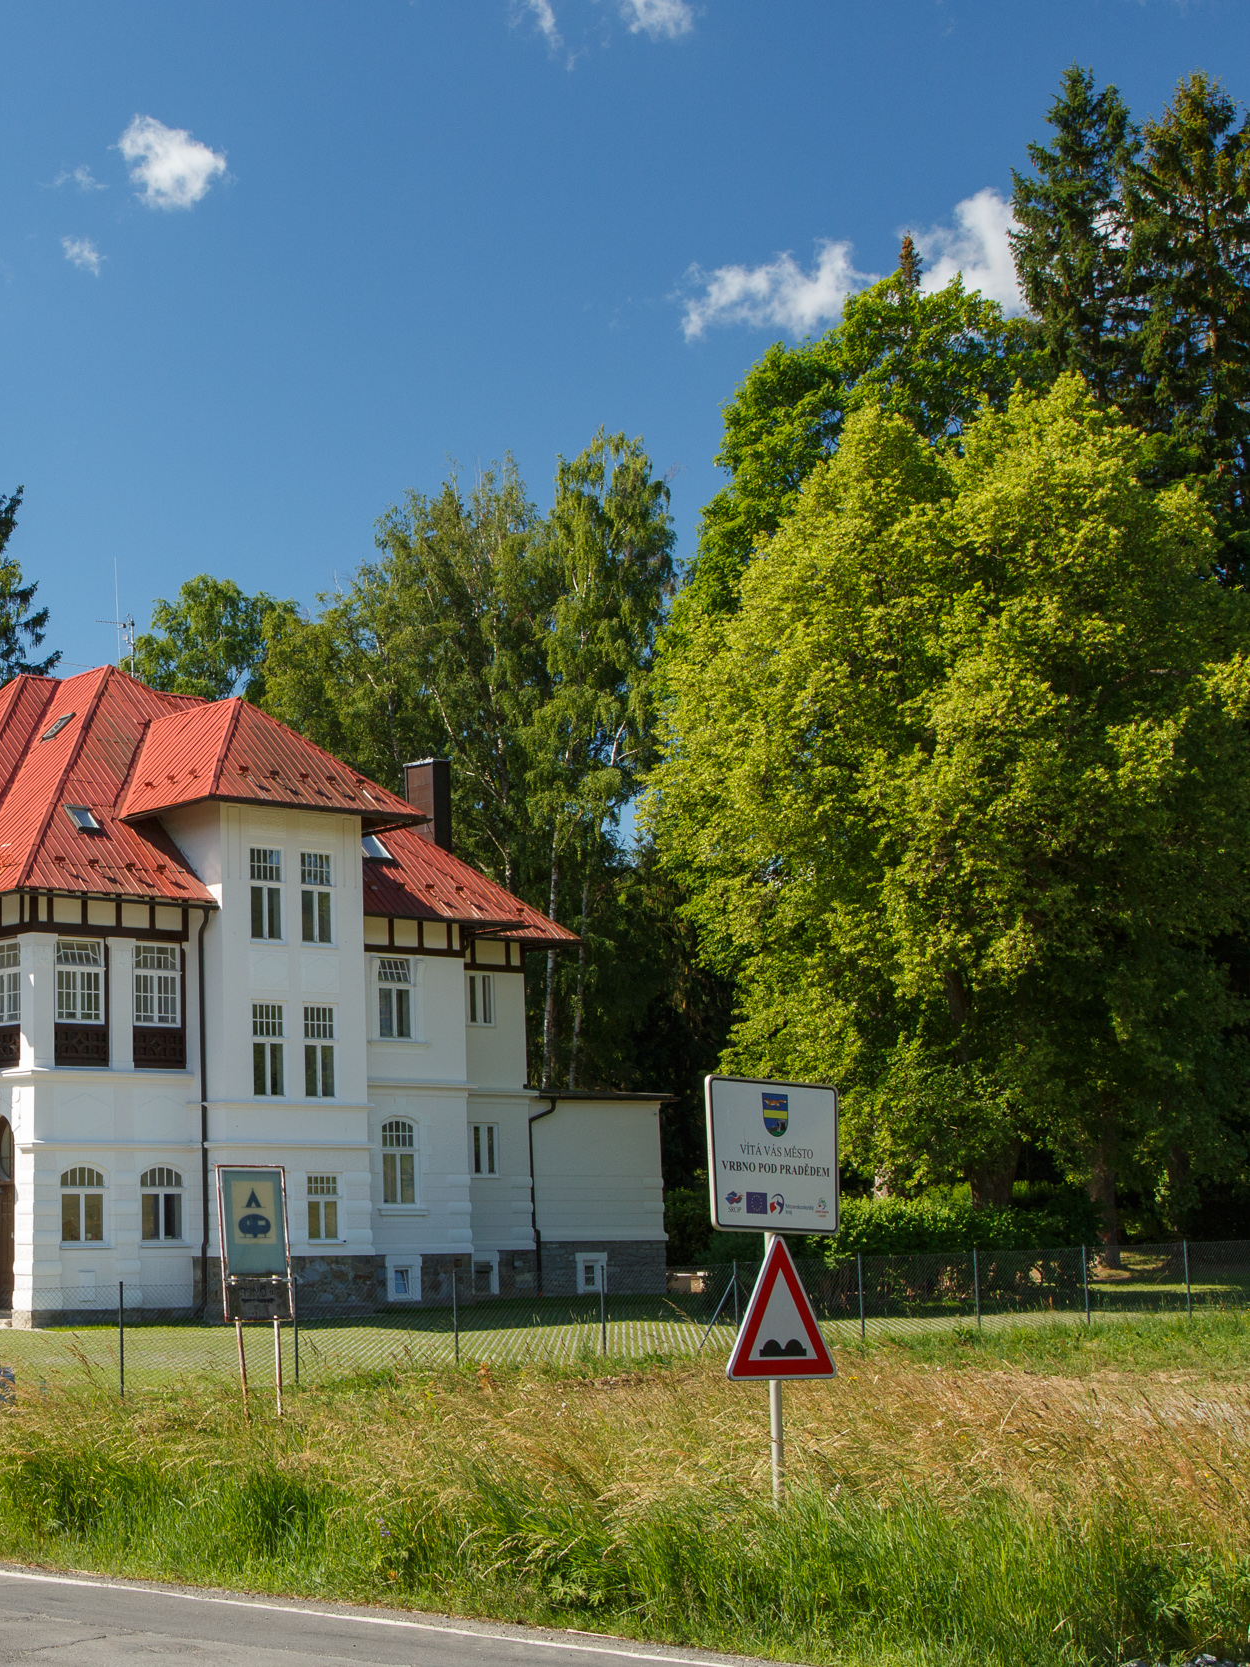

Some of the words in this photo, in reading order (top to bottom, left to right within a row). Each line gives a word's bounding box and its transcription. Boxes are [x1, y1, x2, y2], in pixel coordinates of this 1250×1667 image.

[740, 1142, 762, 1156] VÍTÁ
[764, 1144, 782, 1157] VÁS
[783, 1146, 814, 1159] MĚSTO
[721, 1160, 756, 1173] VRBNO
[758, 1163, 777, 1174] POD
[779, 1163, 830, 1177] PRADĚDEM
